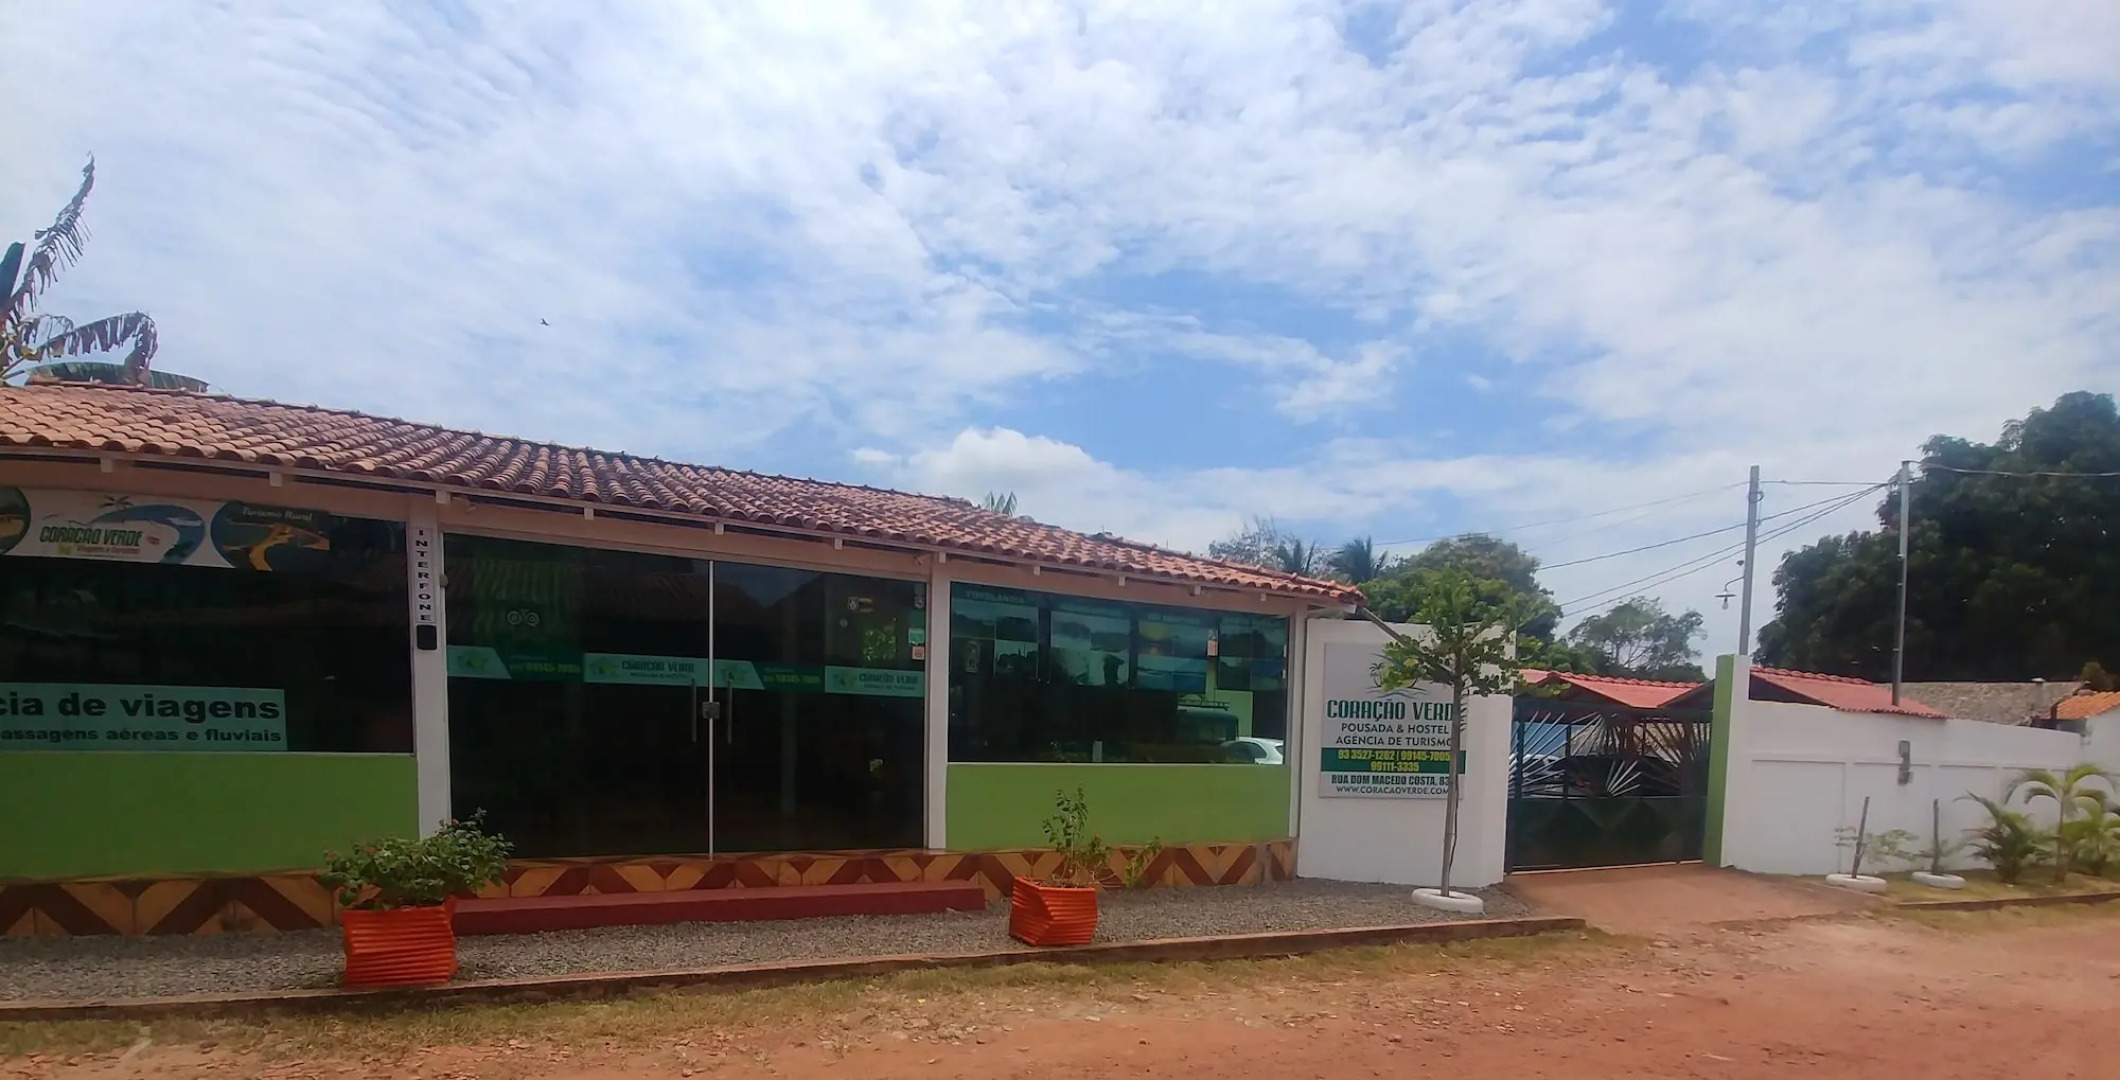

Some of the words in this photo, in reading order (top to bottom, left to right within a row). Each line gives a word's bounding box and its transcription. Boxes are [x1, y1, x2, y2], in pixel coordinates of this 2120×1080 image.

[284, 509, 313, 522] Rural
[415, 529, 431, 622] INTERFONE
[58, 692, 107, 717] de
[119, 693, 281, 725] viagens
[1327, 698, 1406, 722] CORAÇÃO
[1412, 701, 1454, 721] VERD
[105, 727, 179, 742] aéreas
[185, 729, 199, 742] e
[205, 728, 282, 742] fluviais
[1341, 722, 1394, 734] POUSADA
[1396, 723, 1405, 734] &
[1407, 724, 1450, 735] HOSTEL
[1335, 732, 1385, 746] AGÊNCIA
[1387, 736, 1402, 747] DE
[1331, 774, 1349, 785] RUA
[1350, 774, 1371, 785] DOM
[1372, 775, 1407, 785] MACEDO
